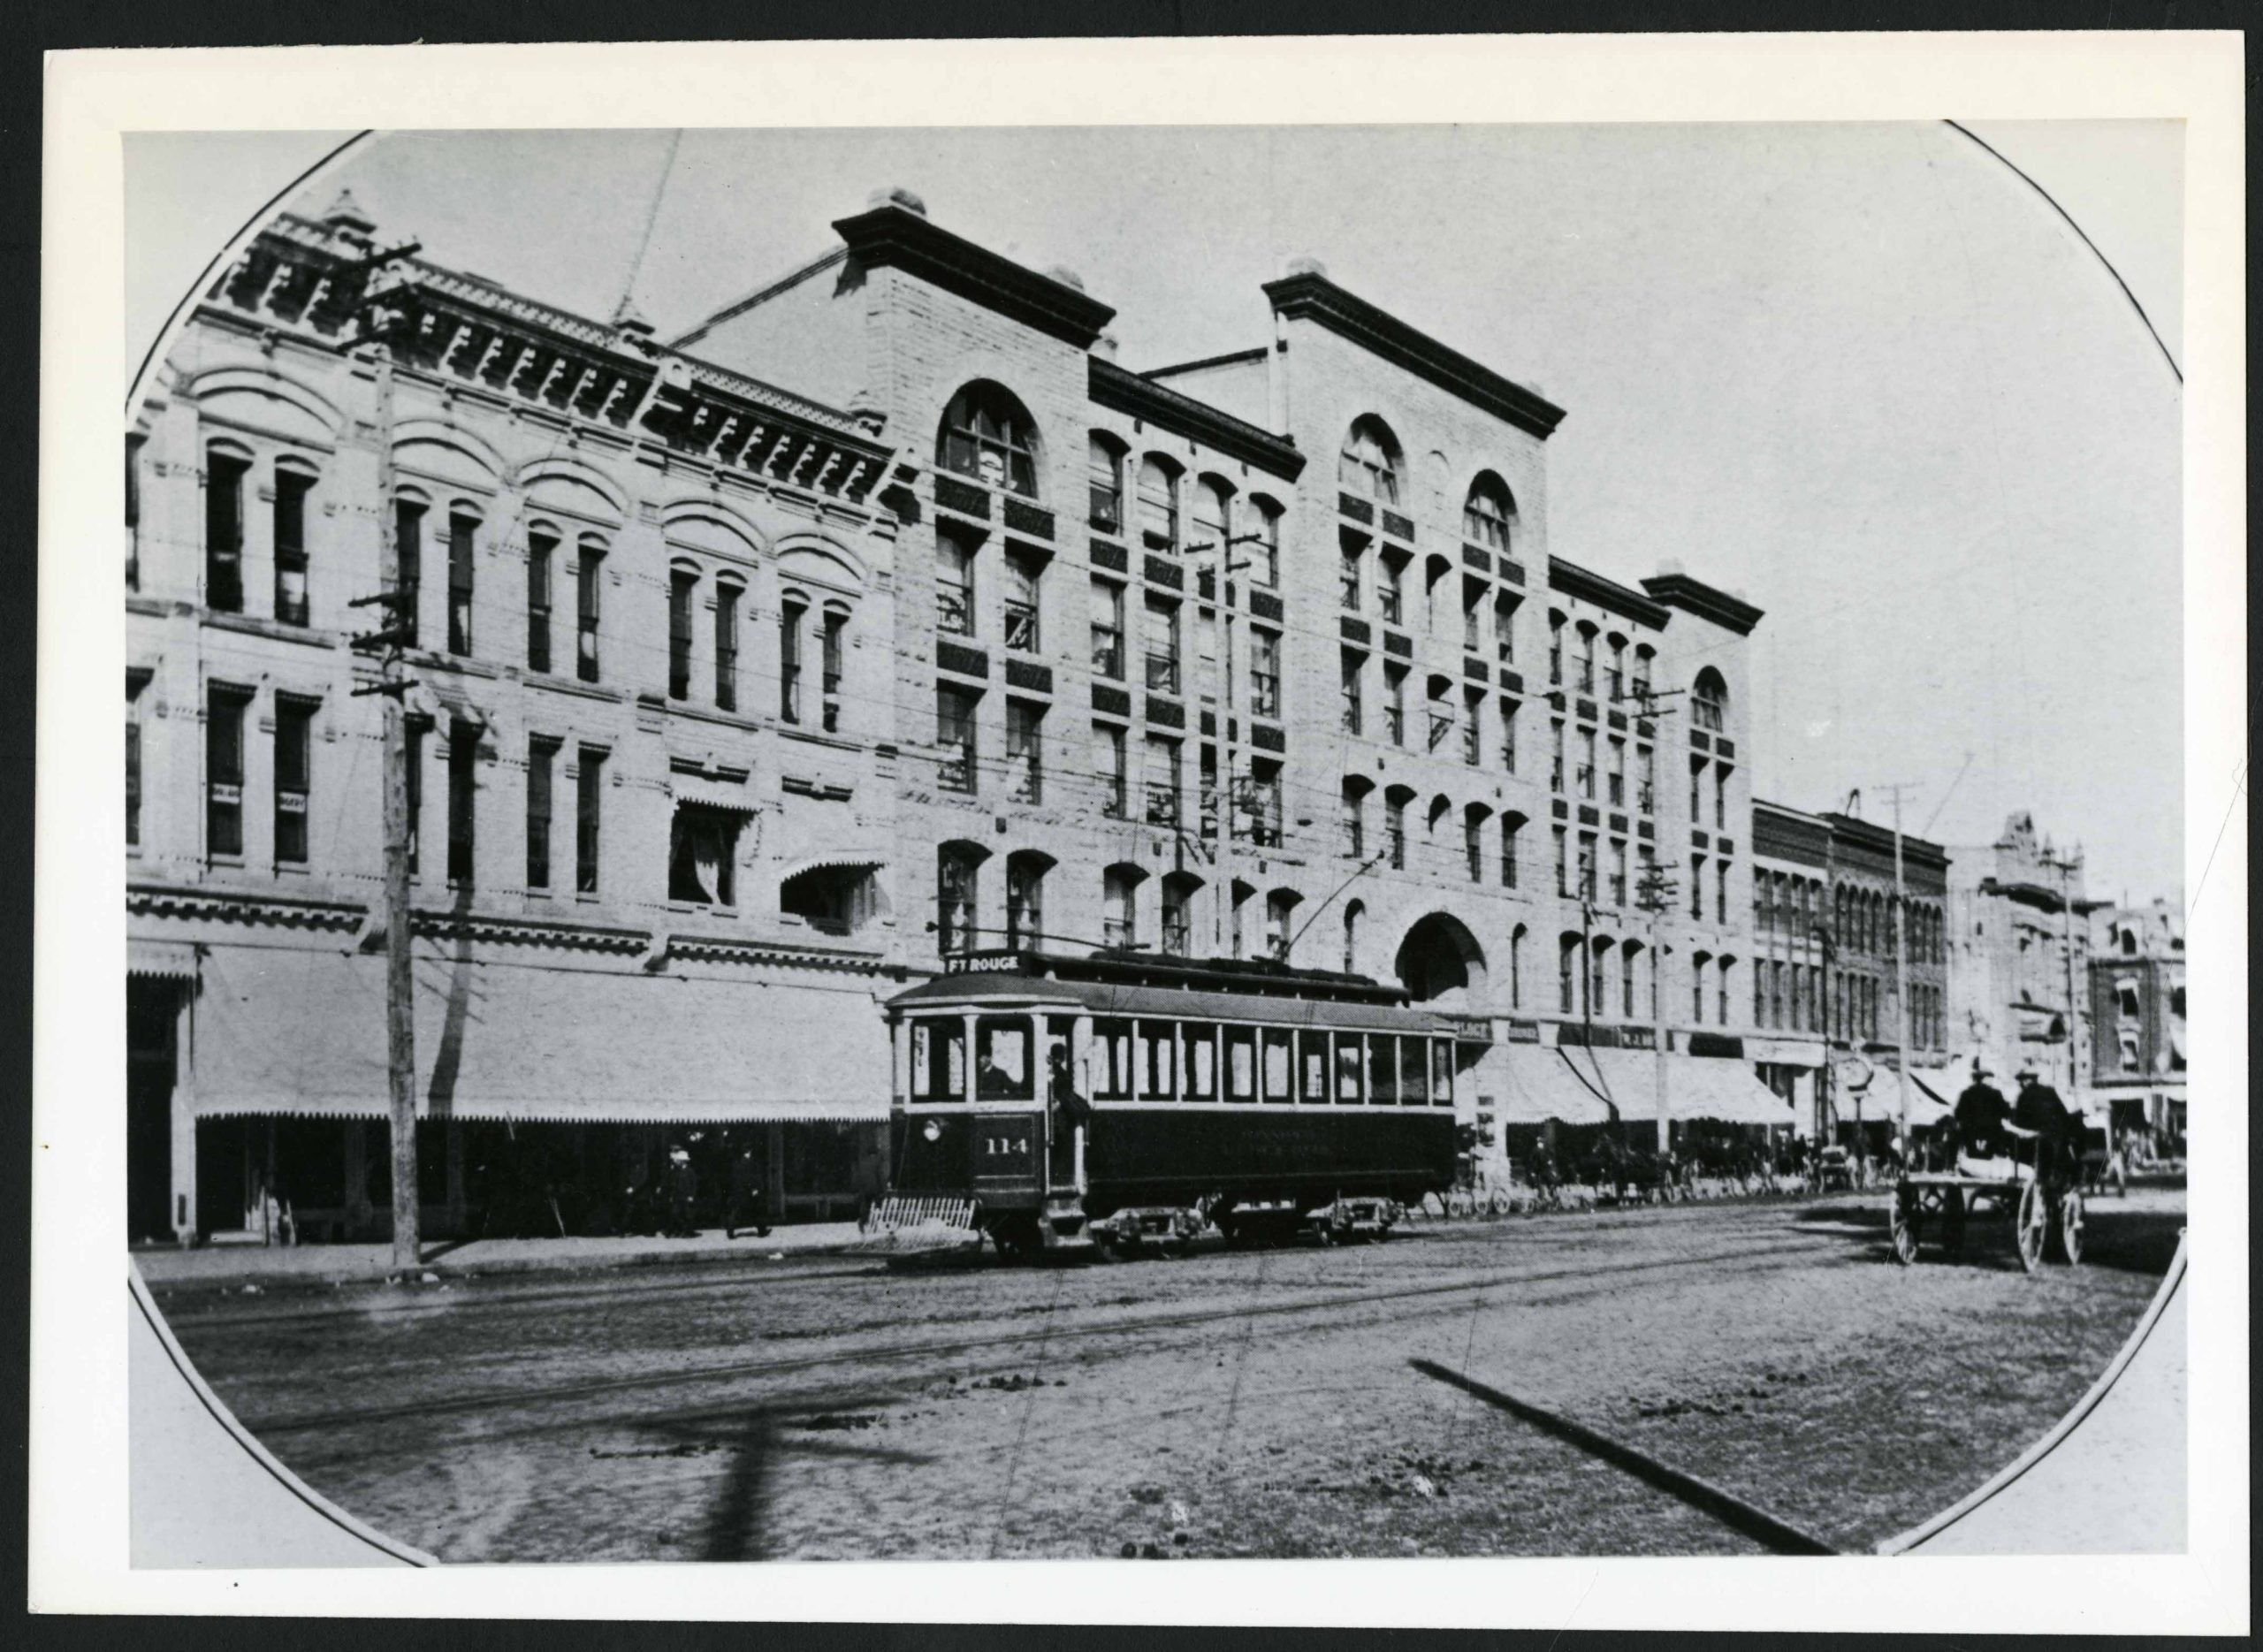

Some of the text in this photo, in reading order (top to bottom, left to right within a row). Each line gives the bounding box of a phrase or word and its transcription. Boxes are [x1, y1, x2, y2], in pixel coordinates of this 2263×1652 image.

[949, 955, 1019, 972] FT ROUGE
[987, 1138, 1029, 1154] 114
